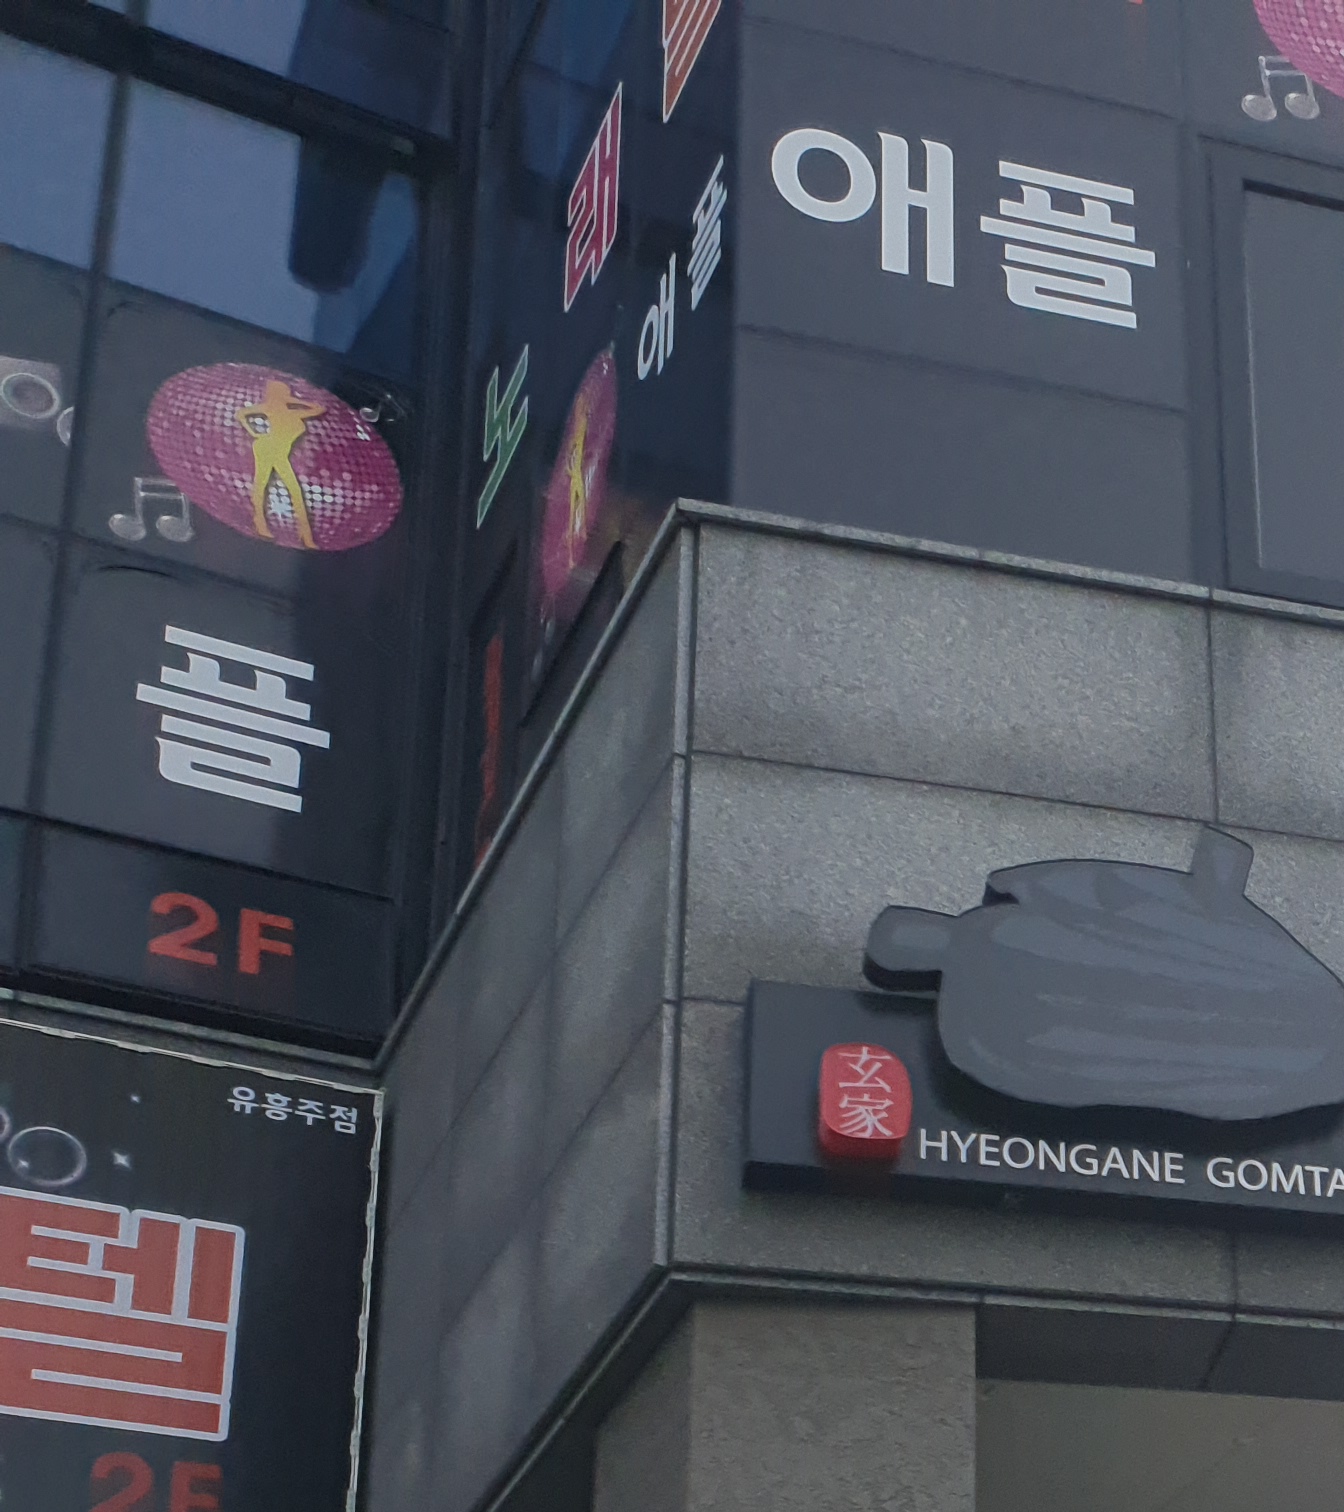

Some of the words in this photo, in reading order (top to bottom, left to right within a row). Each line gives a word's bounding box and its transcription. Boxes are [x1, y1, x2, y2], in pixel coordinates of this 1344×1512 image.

[771, 128, 1155, 328] 애플
[149, 891, 294, 974] 2F
[226, 1085, 360, 1136] 유흥주점
[919, 1129, 1185, 1184] HYEONGANE
